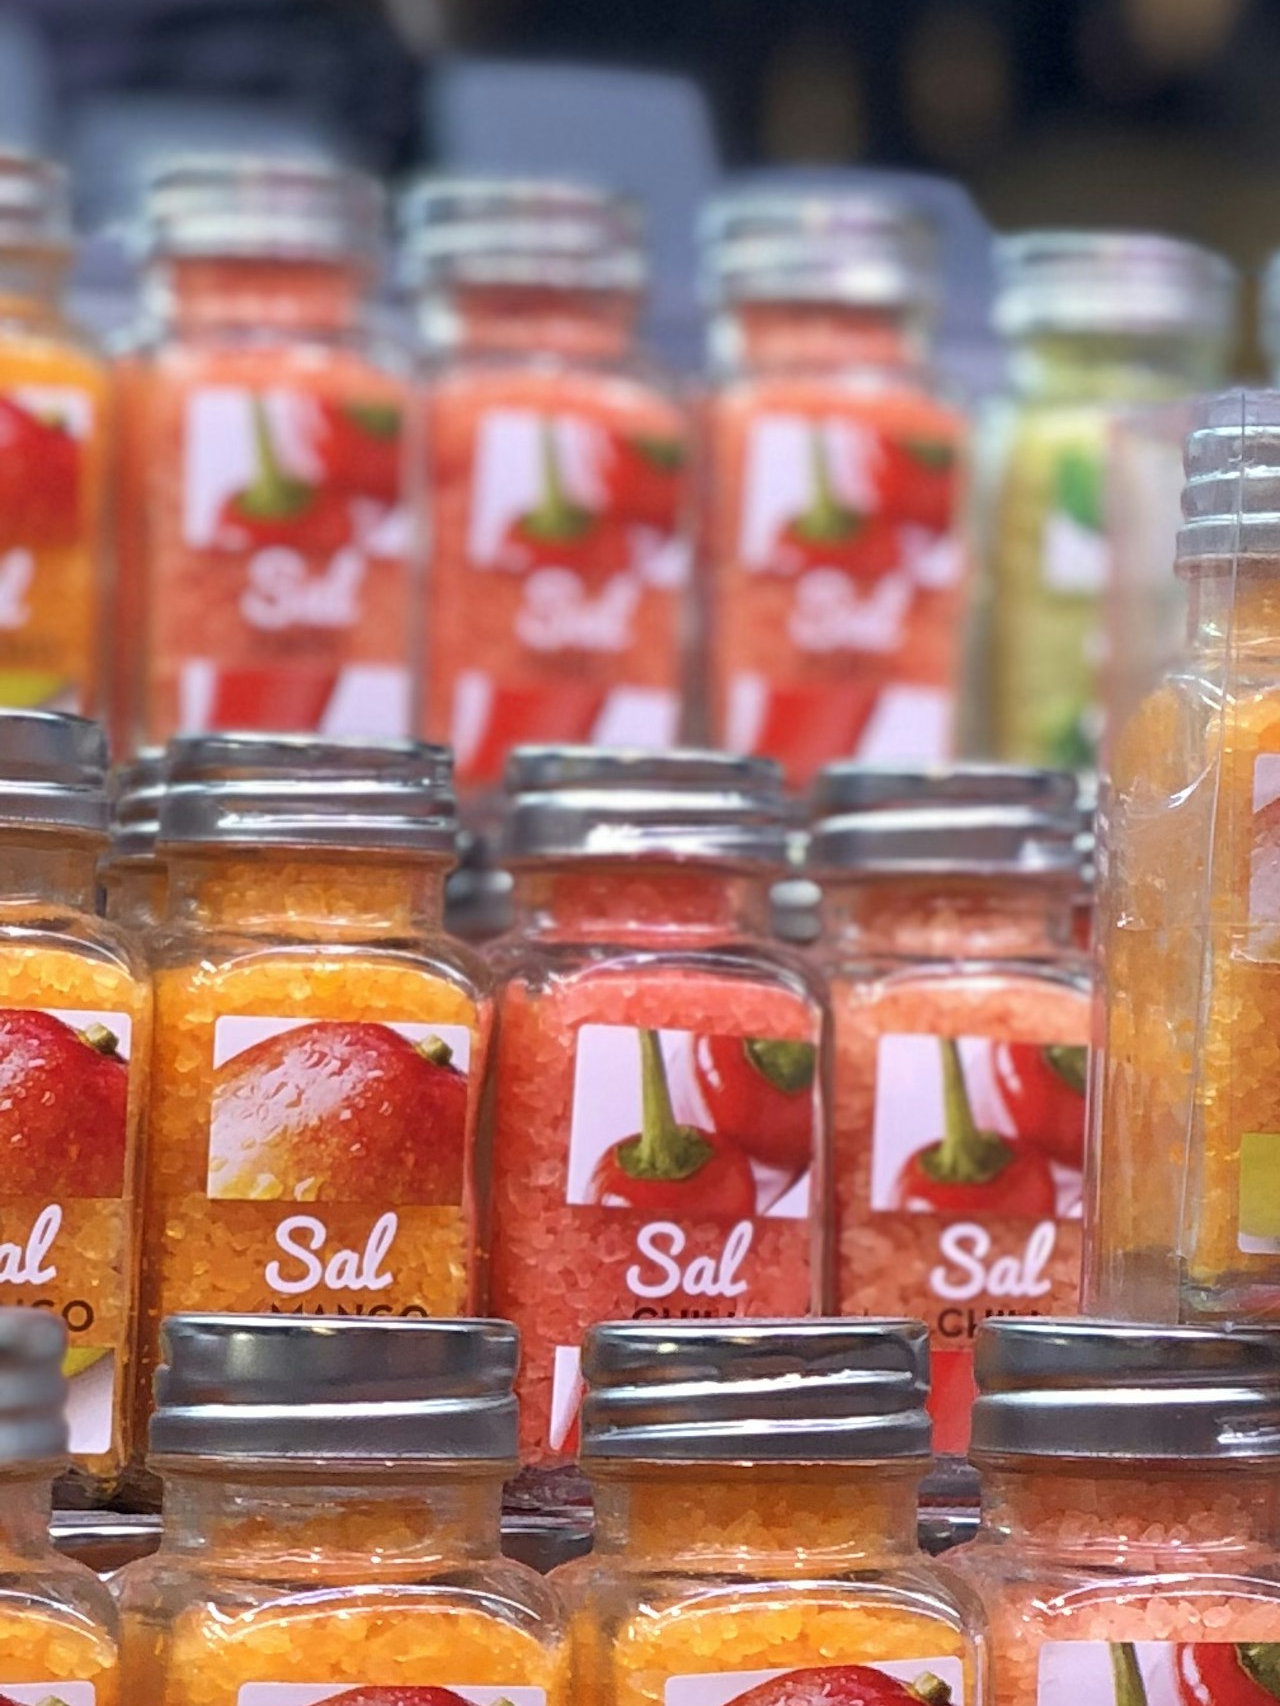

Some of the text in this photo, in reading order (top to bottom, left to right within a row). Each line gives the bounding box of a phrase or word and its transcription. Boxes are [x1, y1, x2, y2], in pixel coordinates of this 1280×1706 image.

[265, 1212, 398, 1293] Sal
[626, 1221, 753, 1297] Sal
[930, 1222, 1056, 1300] Sal
